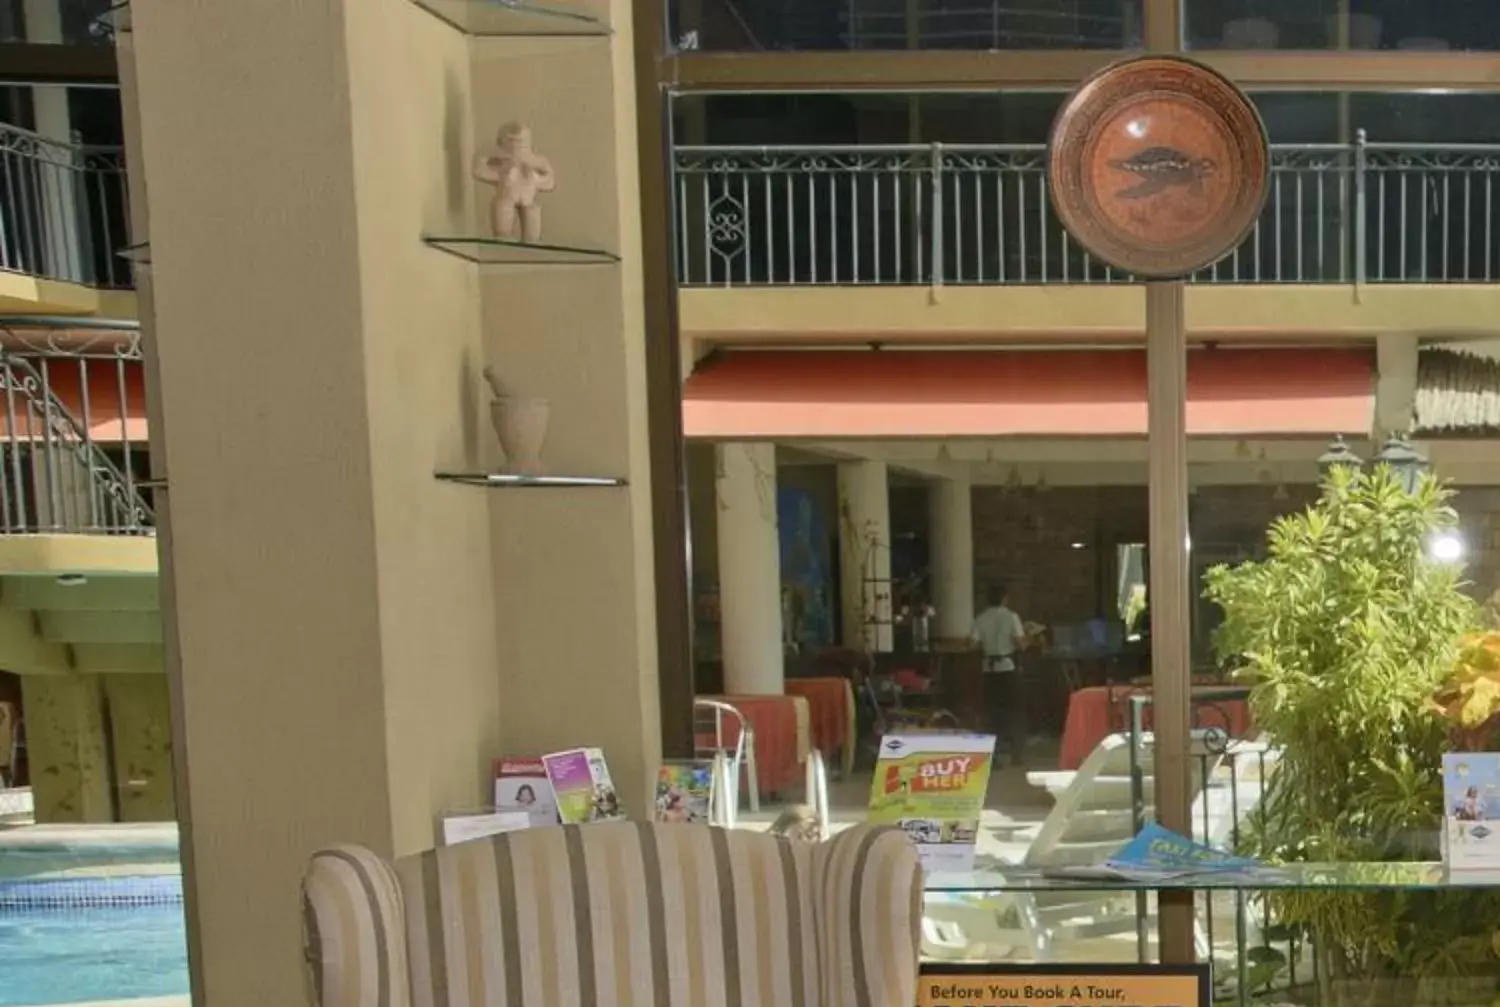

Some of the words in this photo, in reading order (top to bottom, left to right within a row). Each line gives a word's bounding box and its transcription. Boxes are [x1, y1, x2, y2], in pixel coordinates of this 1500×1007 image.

[919, 757, 971, 777] BUY
[930, 985, 984, 1000] Before
[989, 985, 1019, 1000] You
[1023, 985, 1065, 1000] Book
[1069, 985, 1083, 1000] A
[1087, 985, 1126, 1002] Tour,
